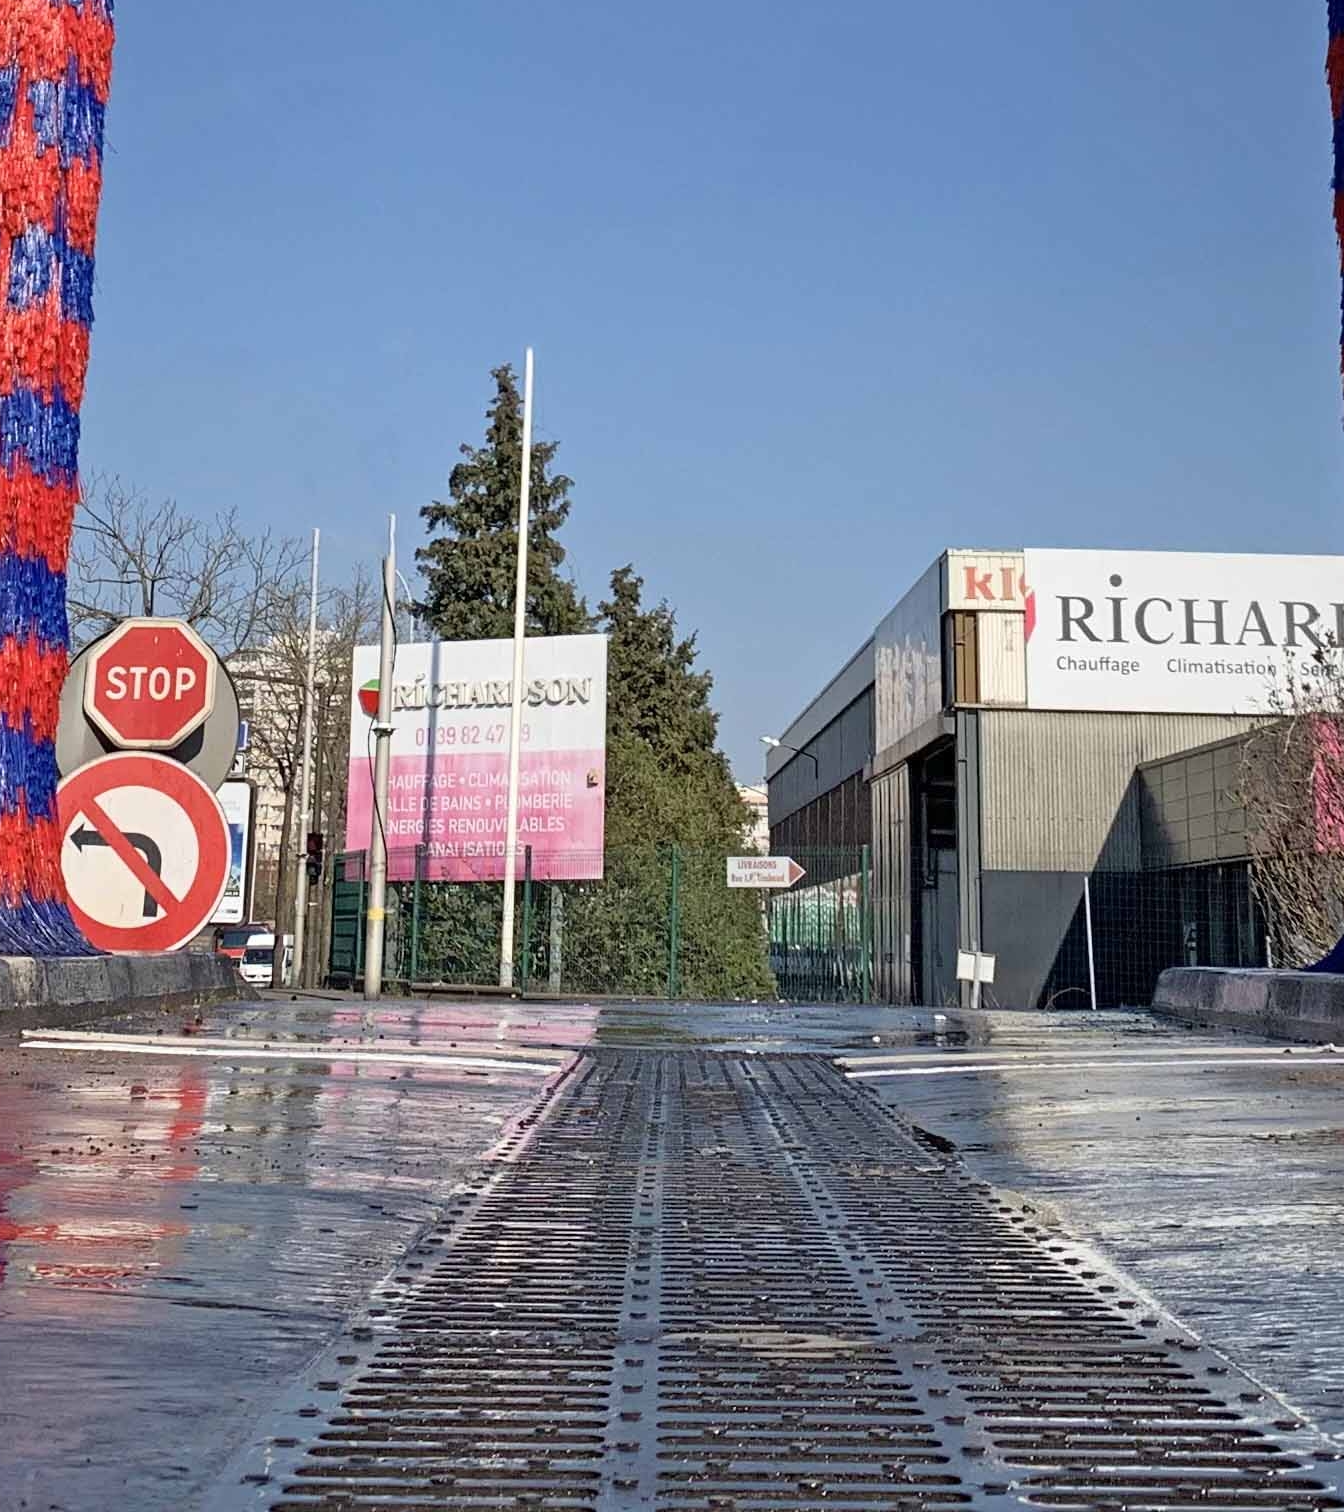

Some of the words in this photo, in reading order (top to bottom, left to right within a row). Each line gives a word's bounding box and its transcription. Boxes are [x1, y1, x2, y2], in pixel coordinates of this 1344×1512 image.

[1057, 655, 1141, 676] Chauffage
[1167, 658, 1277, 675] Climatisation
[105, 665, 197, 701] STOP
[437, 726, 456, 745] 39
[461, 725, 480, 744] 82
[486, 724, 505, 744] 47
[388, 773, 457, 790] HAUFFAGE
[468, 769, 571, 787] CLIMASATION
[387, 796, 417, 812] ALLE
[421, 796, 438, 811] DE
[441, 795, 481, 811] BAINS
[387, 818, 445, 835] NERGIES
[417, 839, 526, 857] CANALISATIOS
